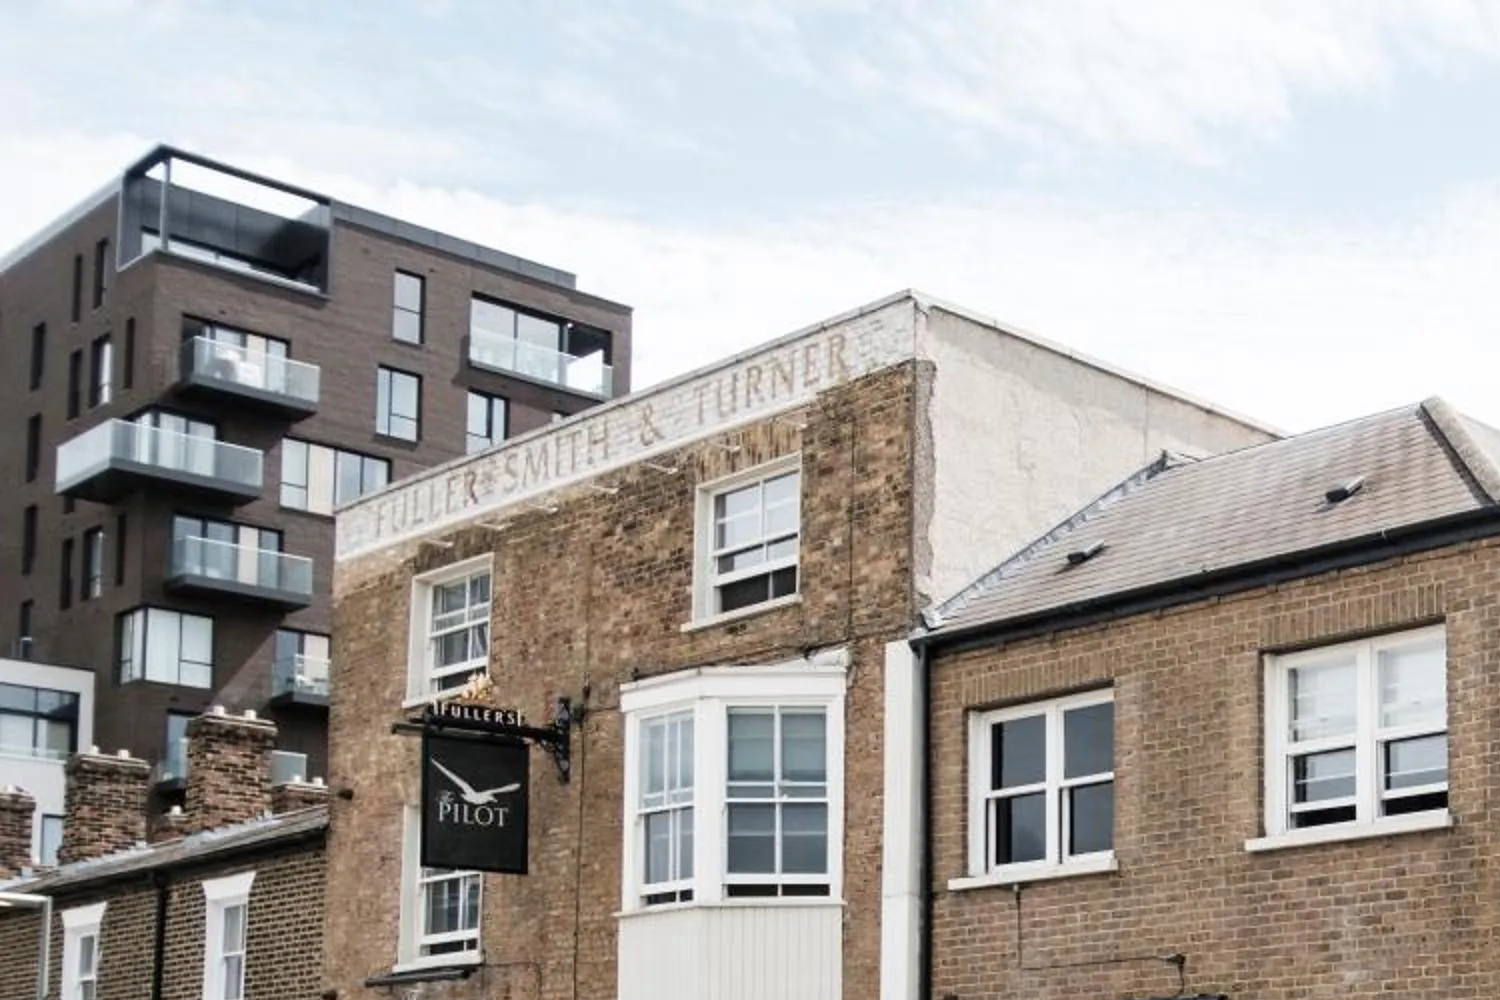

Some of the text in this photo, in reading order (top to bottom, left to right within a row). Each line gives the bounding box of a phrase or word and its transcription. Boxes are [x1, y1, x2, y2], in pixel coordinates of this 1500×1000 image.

[375, 333, 850, 538] FULLER SMITH & TURNER
[438, 800, 510, 828] PILOT
